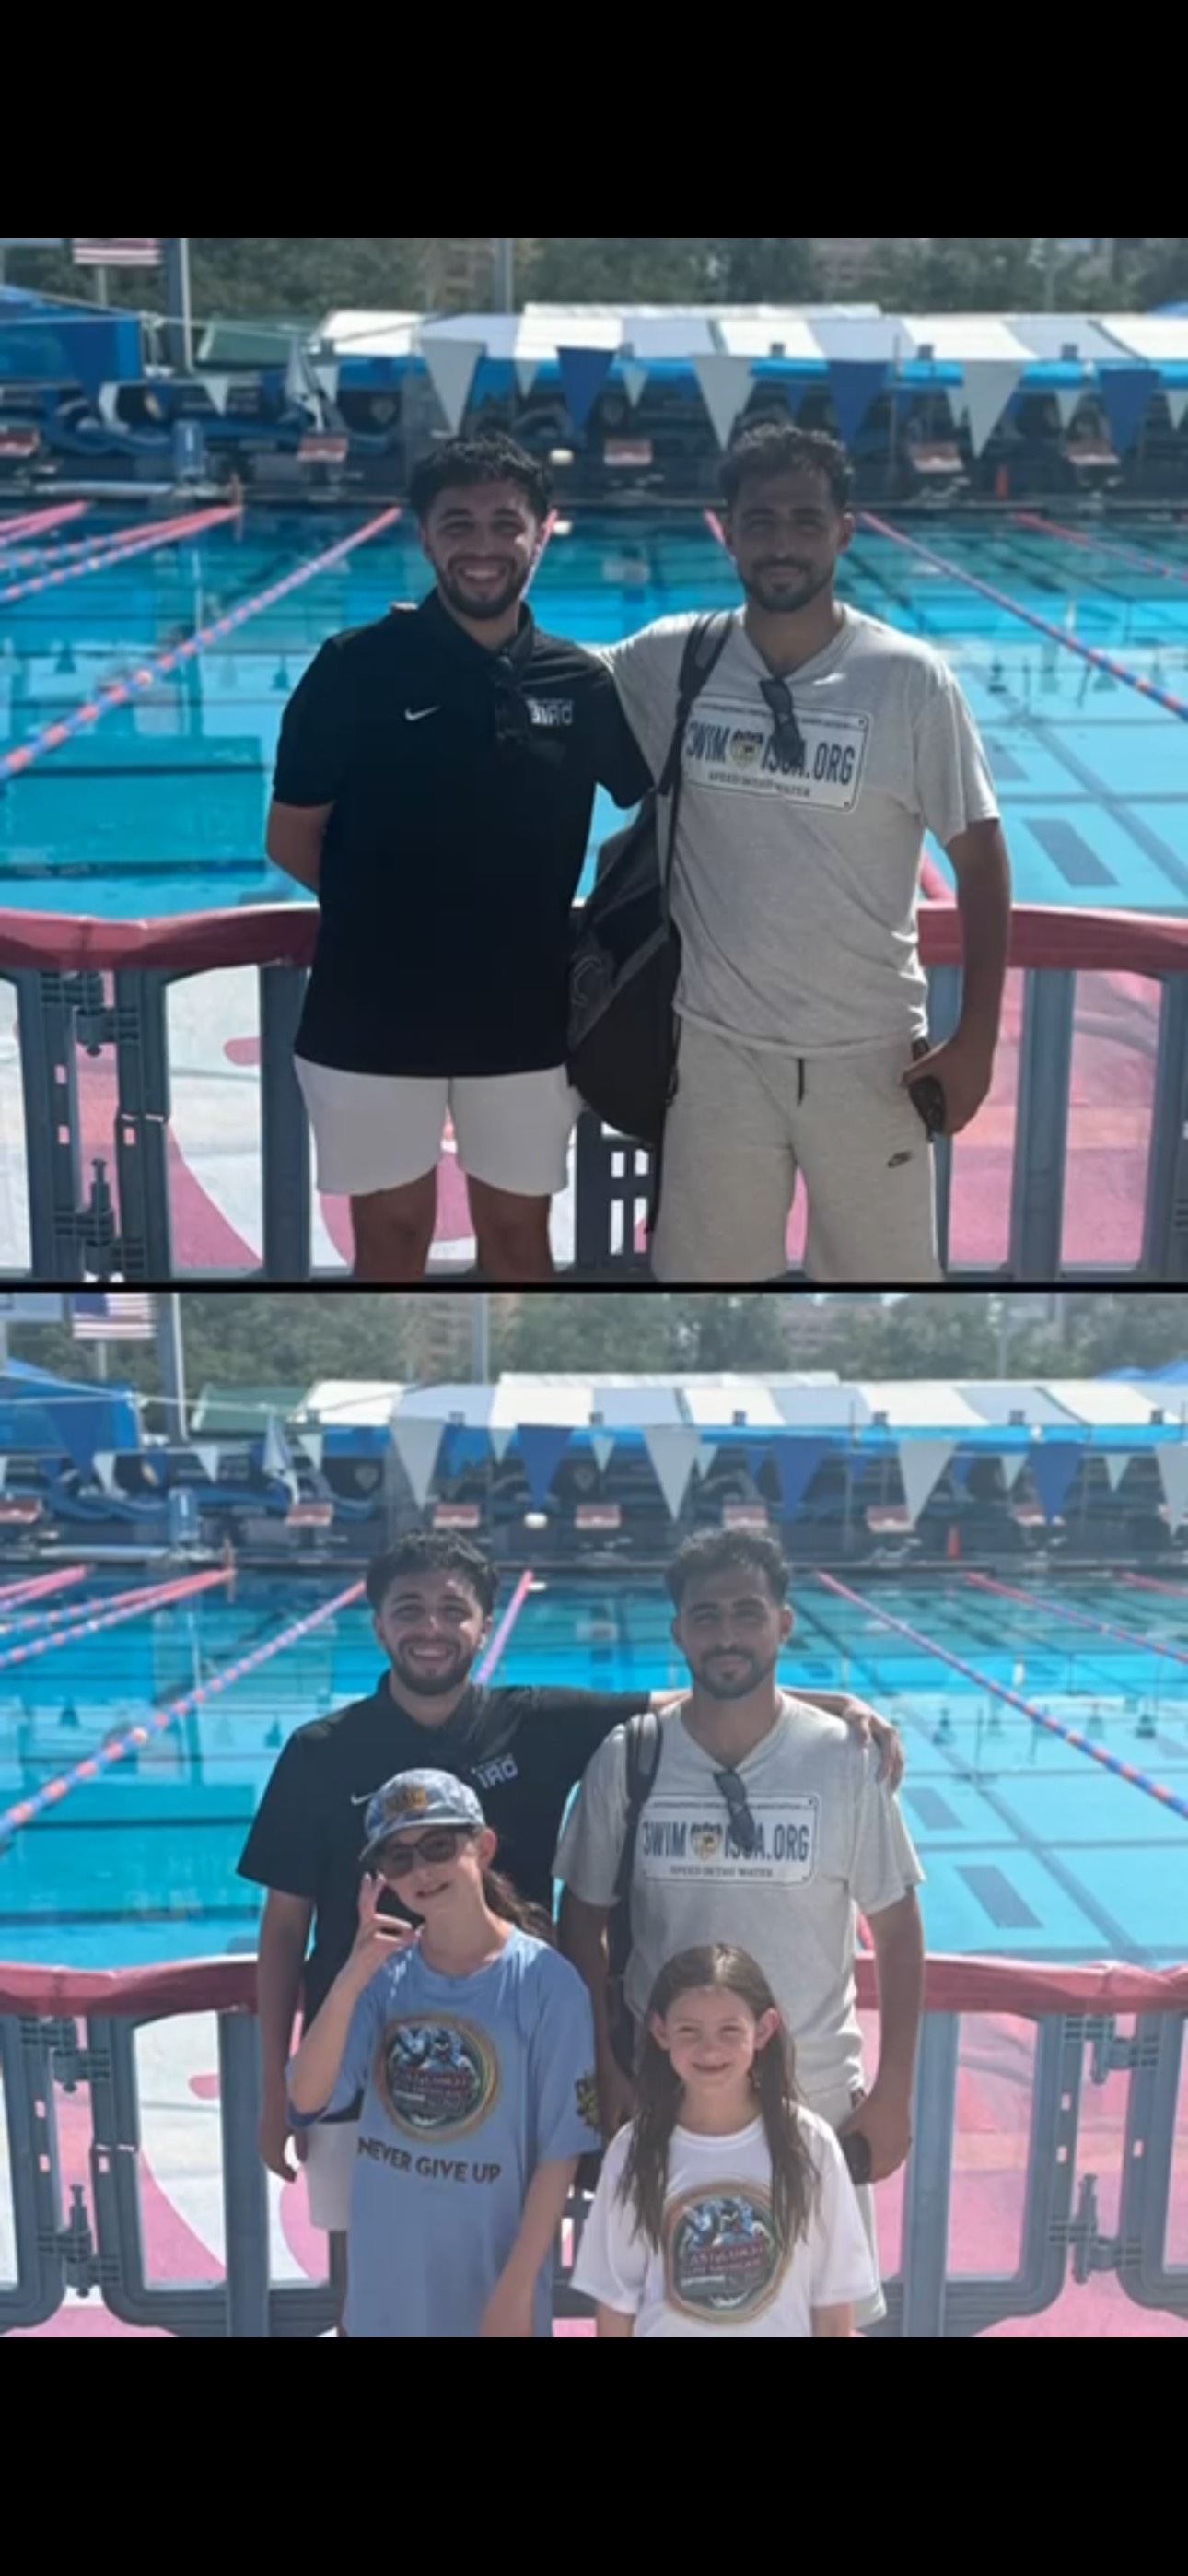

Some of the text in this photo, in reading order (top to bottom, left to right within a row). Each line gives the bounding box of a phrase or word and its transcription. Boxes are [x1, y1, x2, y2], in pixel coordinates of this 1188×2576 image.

[356, 2136, 502, 2184] NEVER GIVE UP
